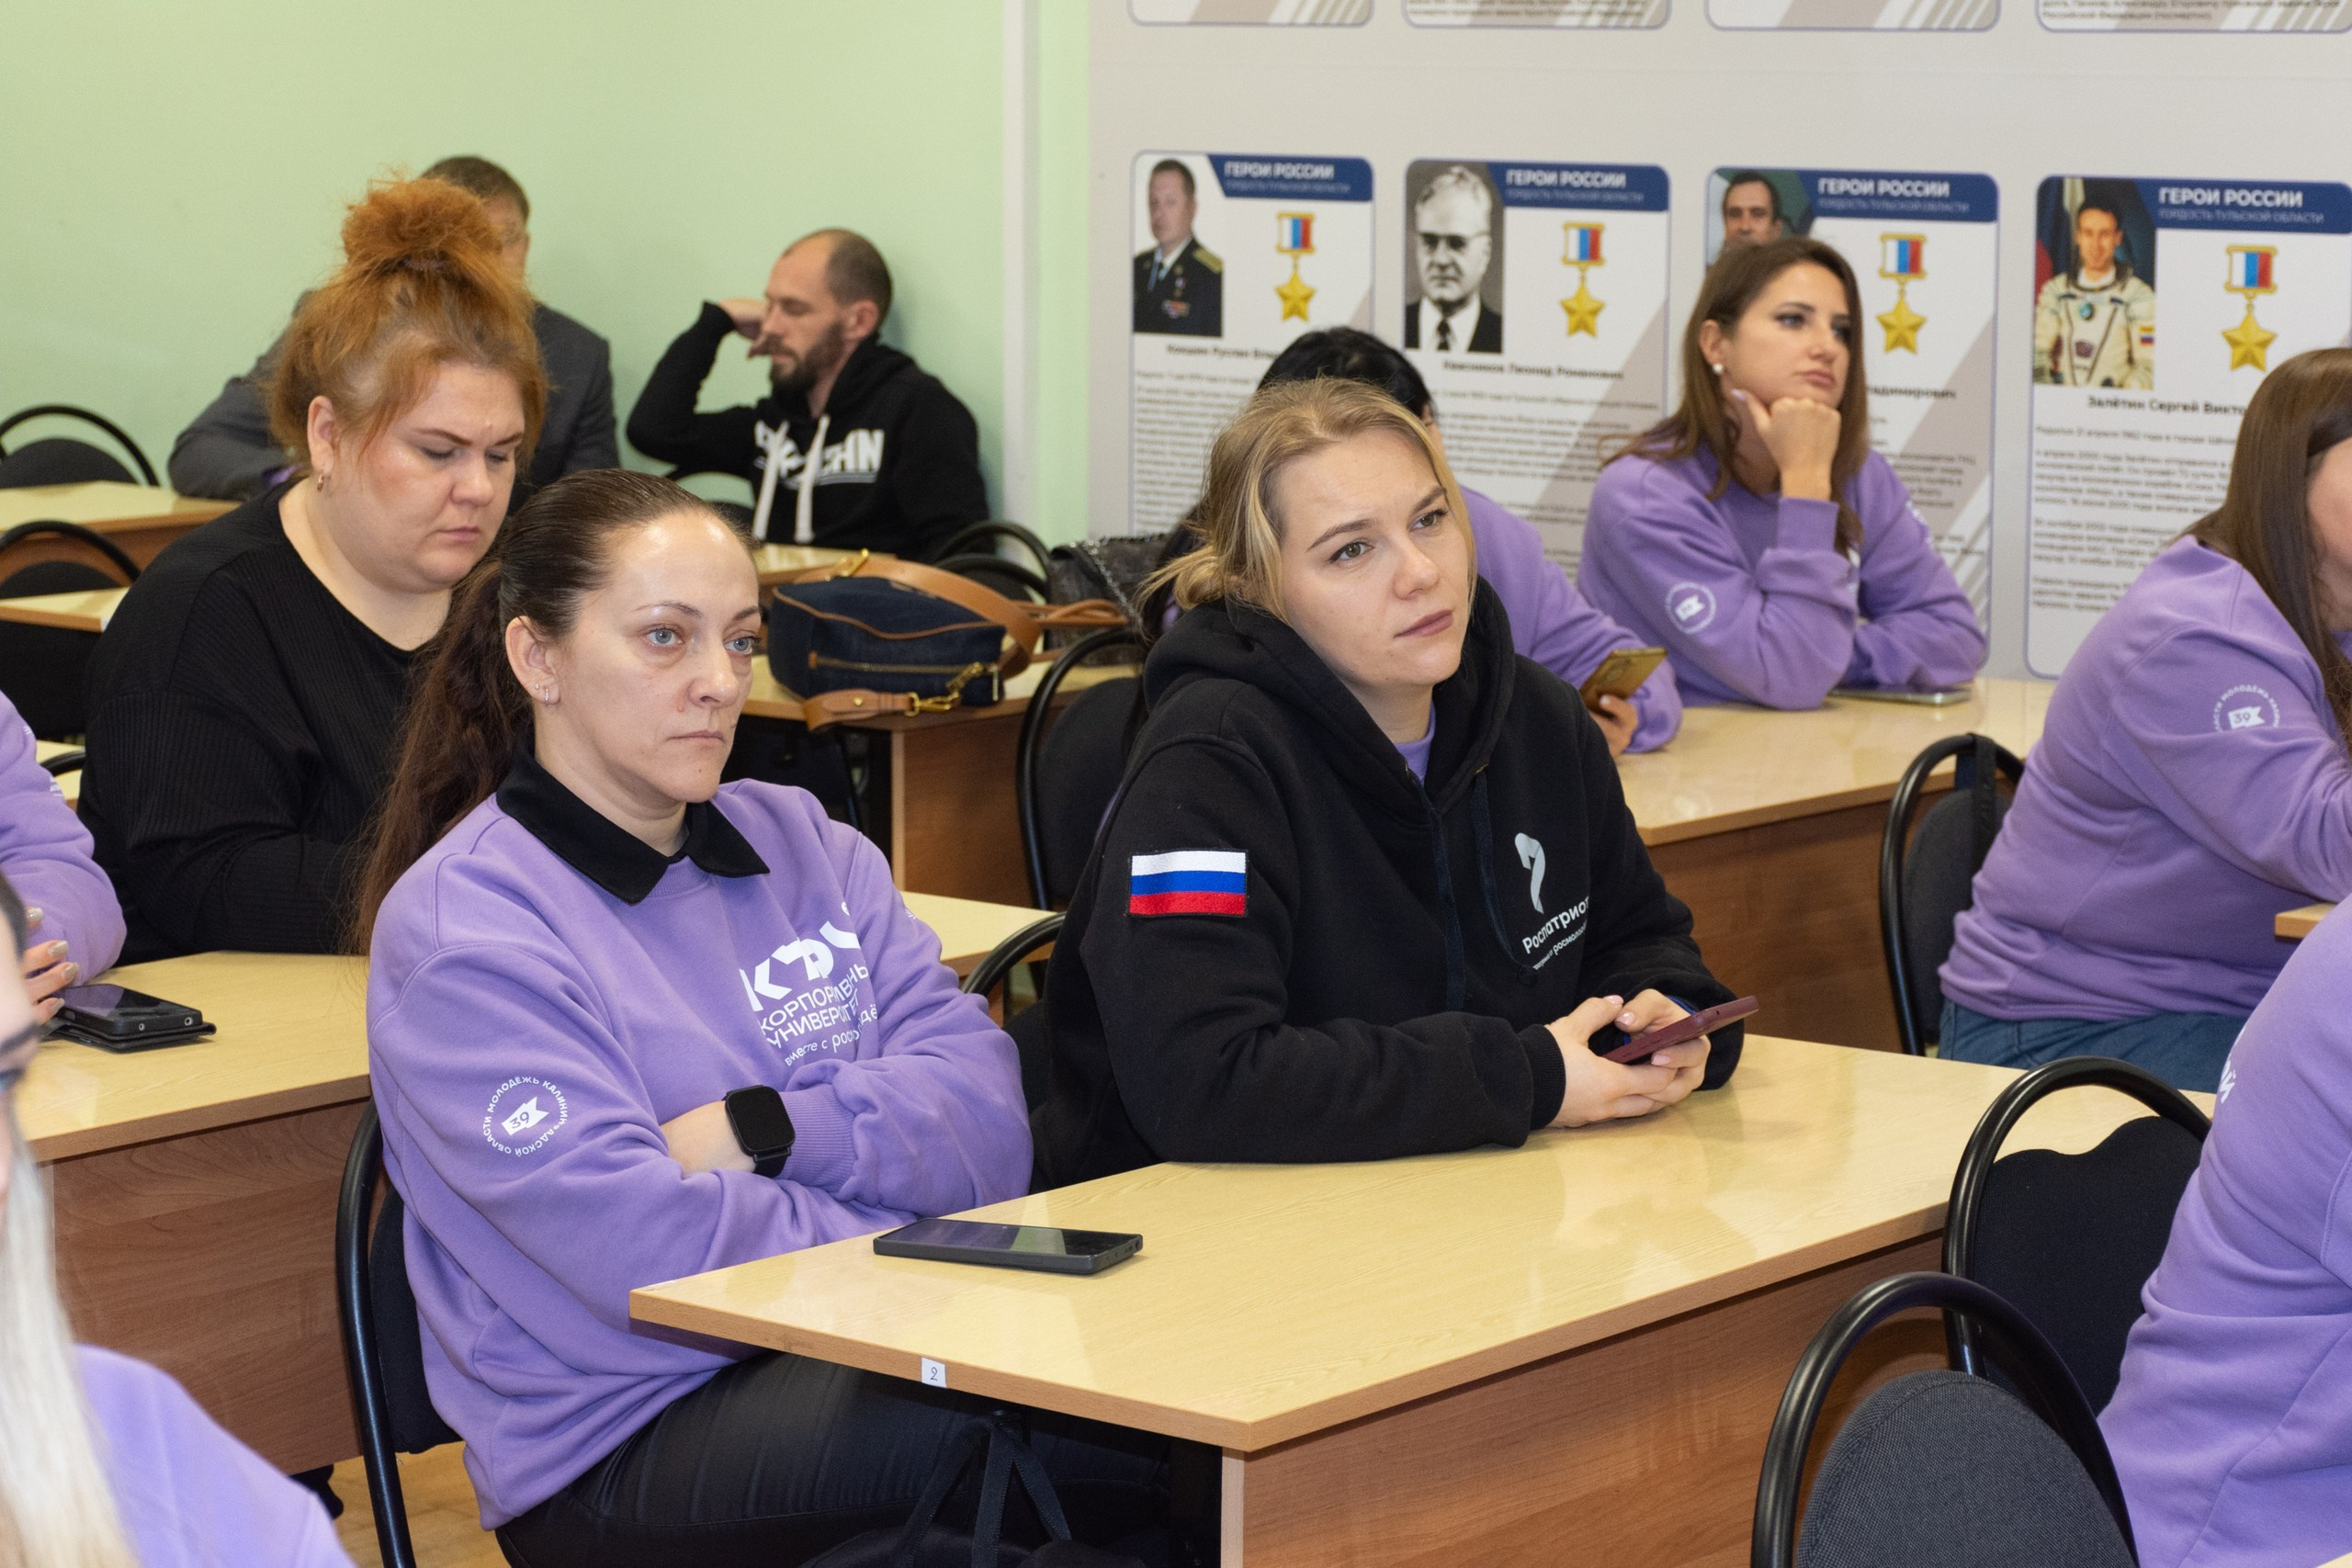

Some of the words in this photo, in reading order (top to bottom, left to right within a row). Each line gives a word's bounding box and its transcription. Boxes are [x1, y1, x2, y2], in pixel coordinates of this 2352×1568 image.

[1224, 161, 1272, 178] ГЕРОИ
[1273, 162, 1334, 180] РОССИИ
[1506, 169, 1557, 187] ГЕРОИ
[1560, 170, 1627, 189] РОССИИ
[1817, 177, 1875, 196] ГЕРОИ
[1877, 179, 1950, 197] РОССИИ
[2159, 186, 2220, 205] ГЕРОИ
[2224, 188, 2302, 208] РОССИИ
[2149, 396, 2199, 413] Сергей
[2203, 402, 2248, 414] Викто
[509, 1111, 530, 1129] 39
[482, 1116, 512, 1155] ОБЛАСТИ
[930, 1366, 938, 1382] 2
